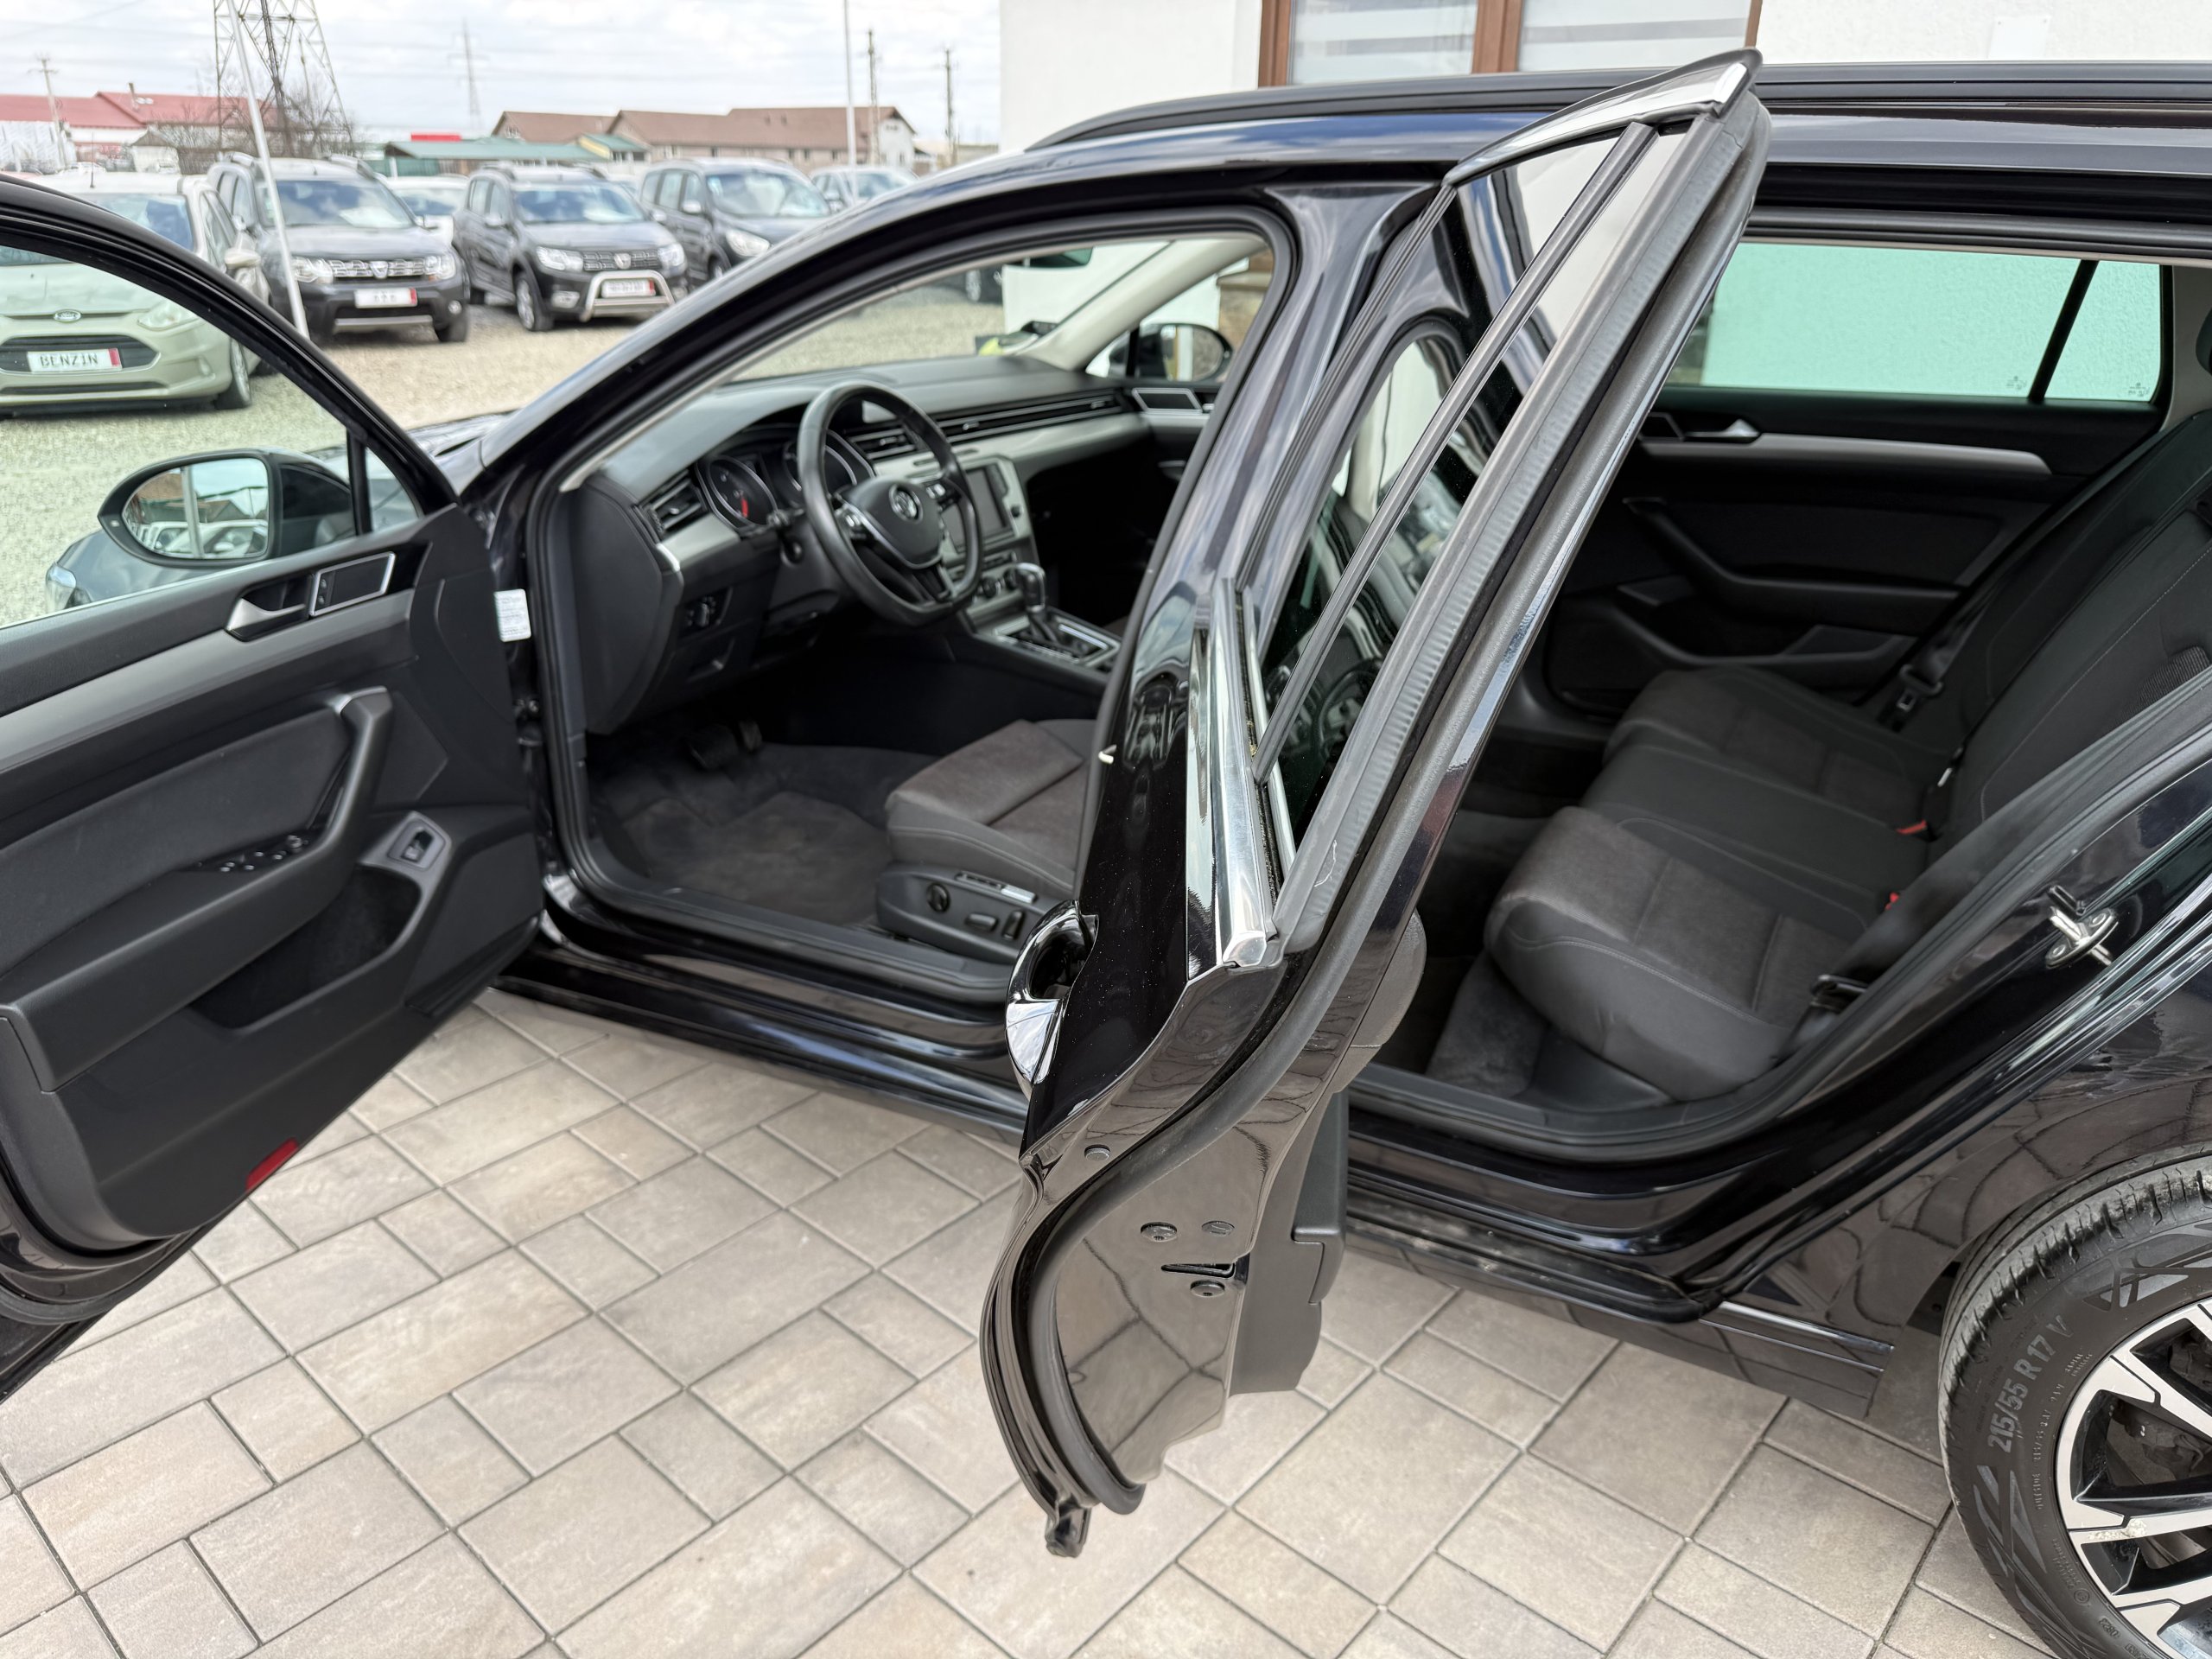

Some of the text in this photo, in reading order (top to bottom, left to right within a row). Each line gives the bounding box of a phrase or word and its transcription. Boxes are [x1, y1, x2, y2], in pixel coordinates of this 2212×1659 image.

[40, 353, 99, 367] BENZIN
[2046, 1315, 2074, 1338] V
[2027, 1334, 2056, 1363] 17
[2013, 1358, 2043, 1381] R
[1988, 1378, 2029, 1453] 215/55
